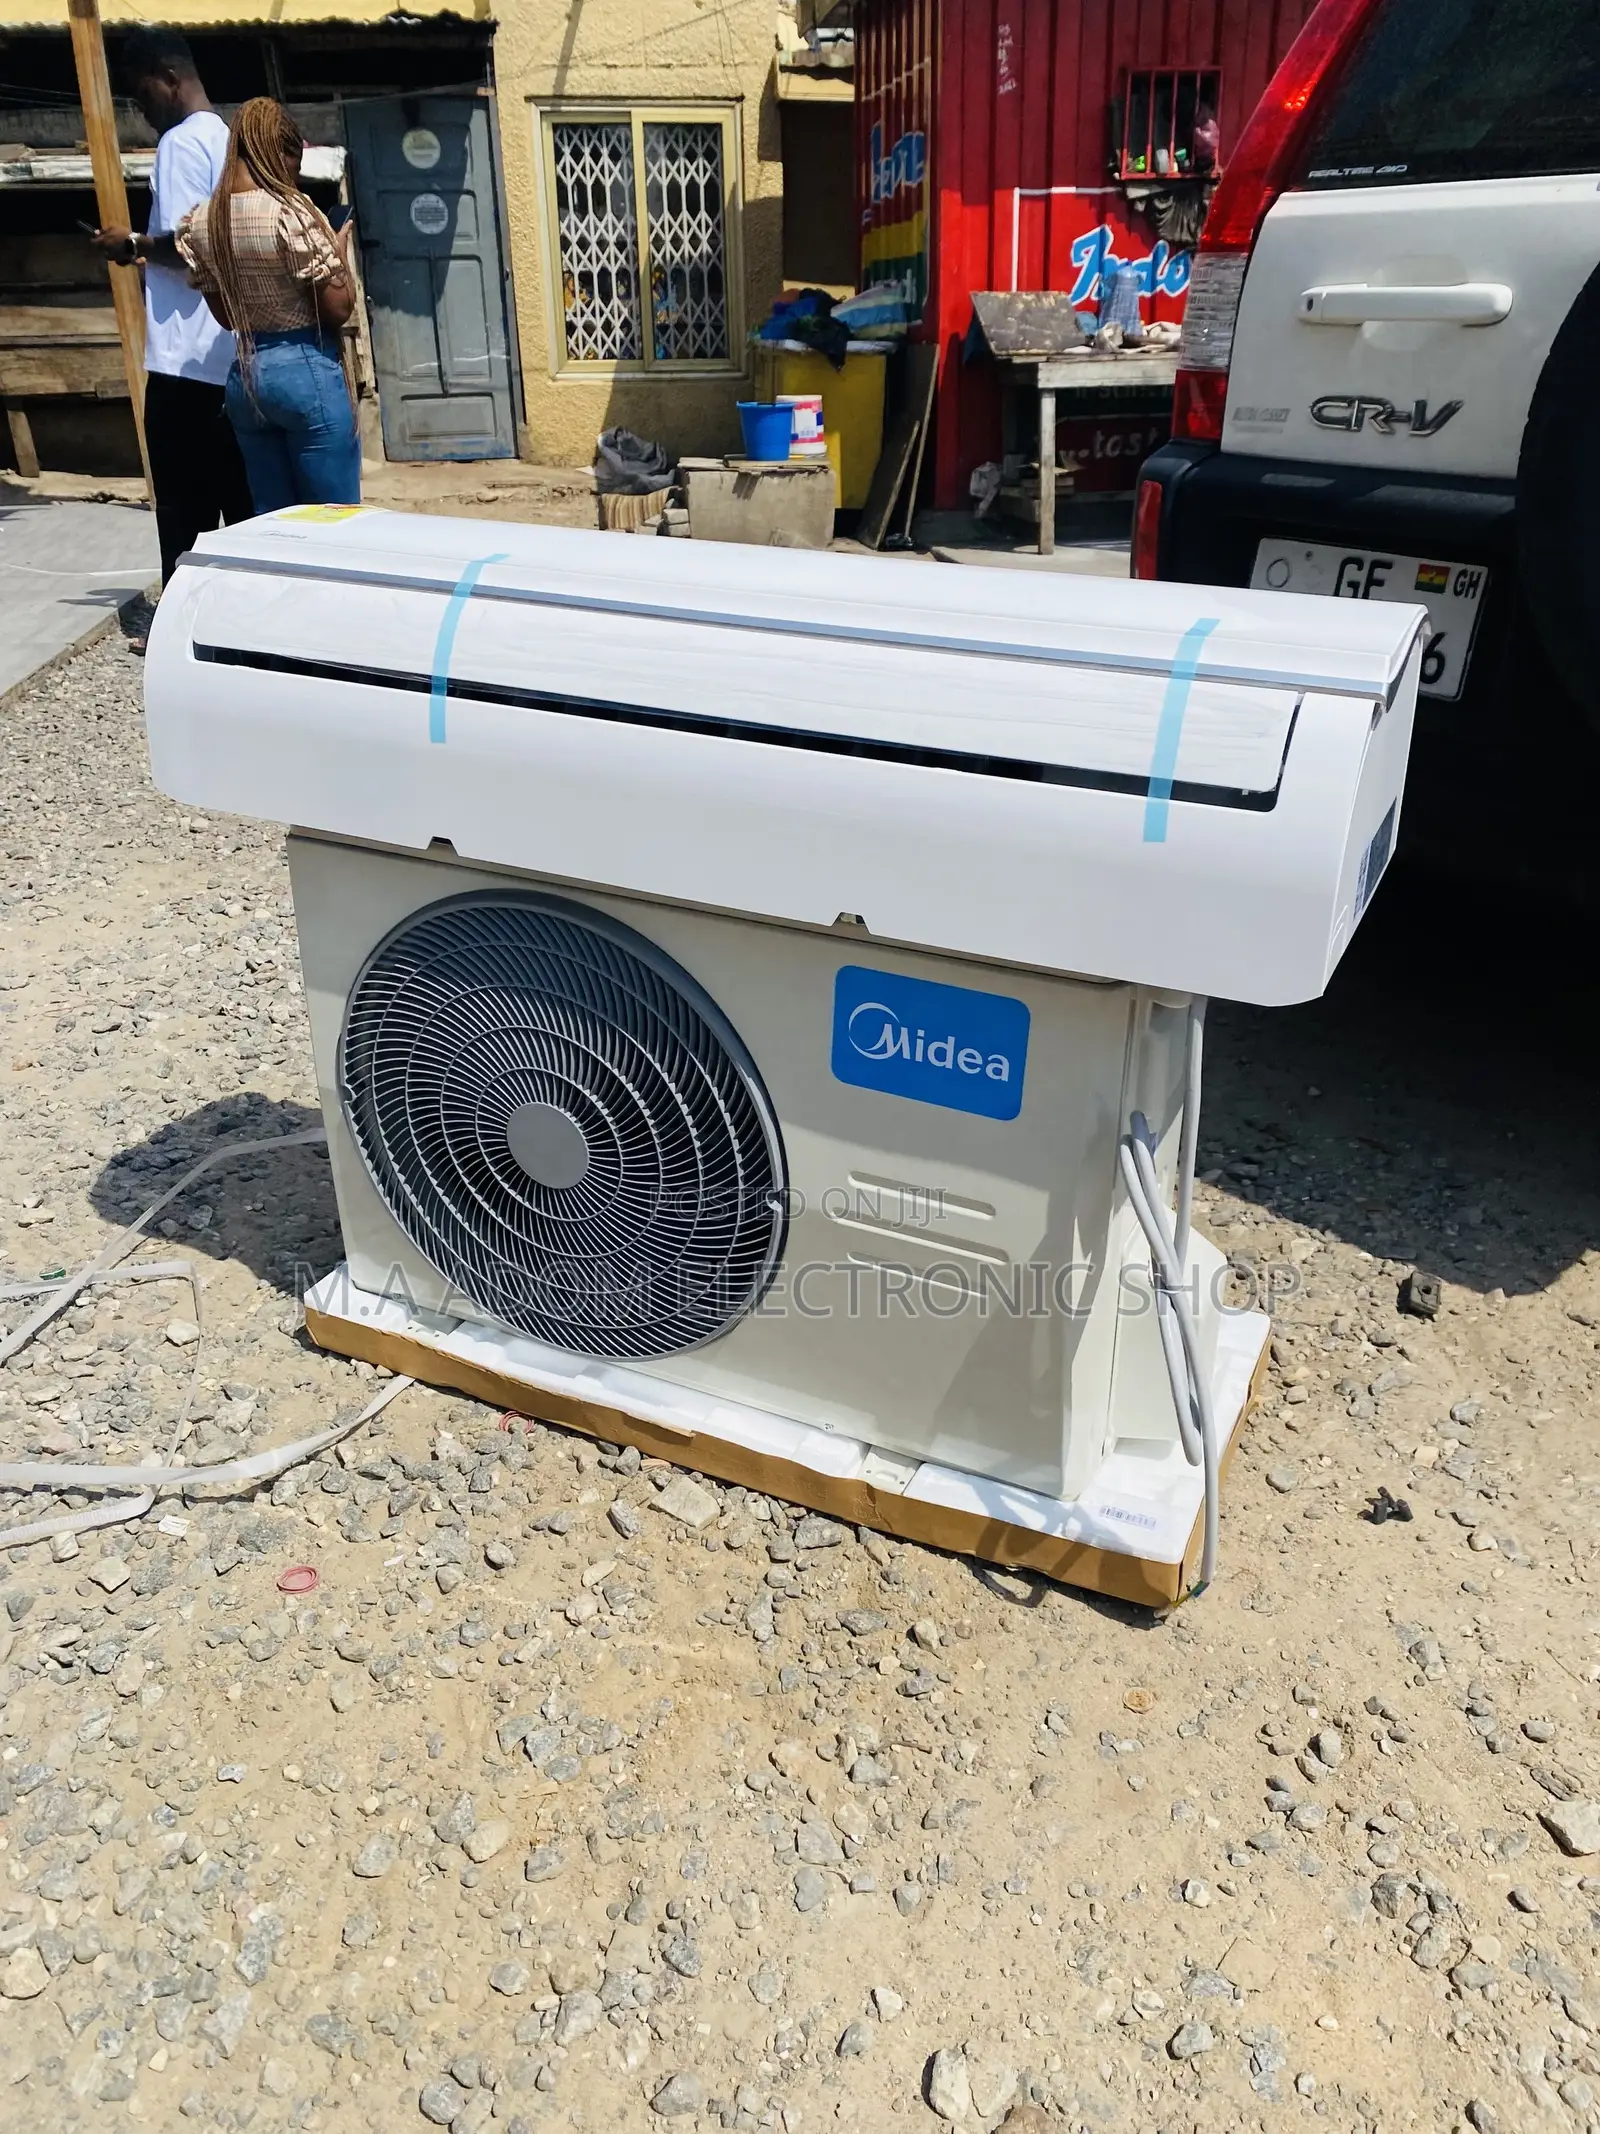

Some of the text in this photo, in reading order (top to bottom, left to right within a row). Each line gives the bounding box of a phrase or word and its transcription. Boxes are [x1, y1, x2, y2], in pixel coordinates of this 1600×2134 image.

[1309, 394, 1464, 437] CR-V
[1453, 567, 1482, 599] GH
[848, 1002, 1010, 1082] Midea
